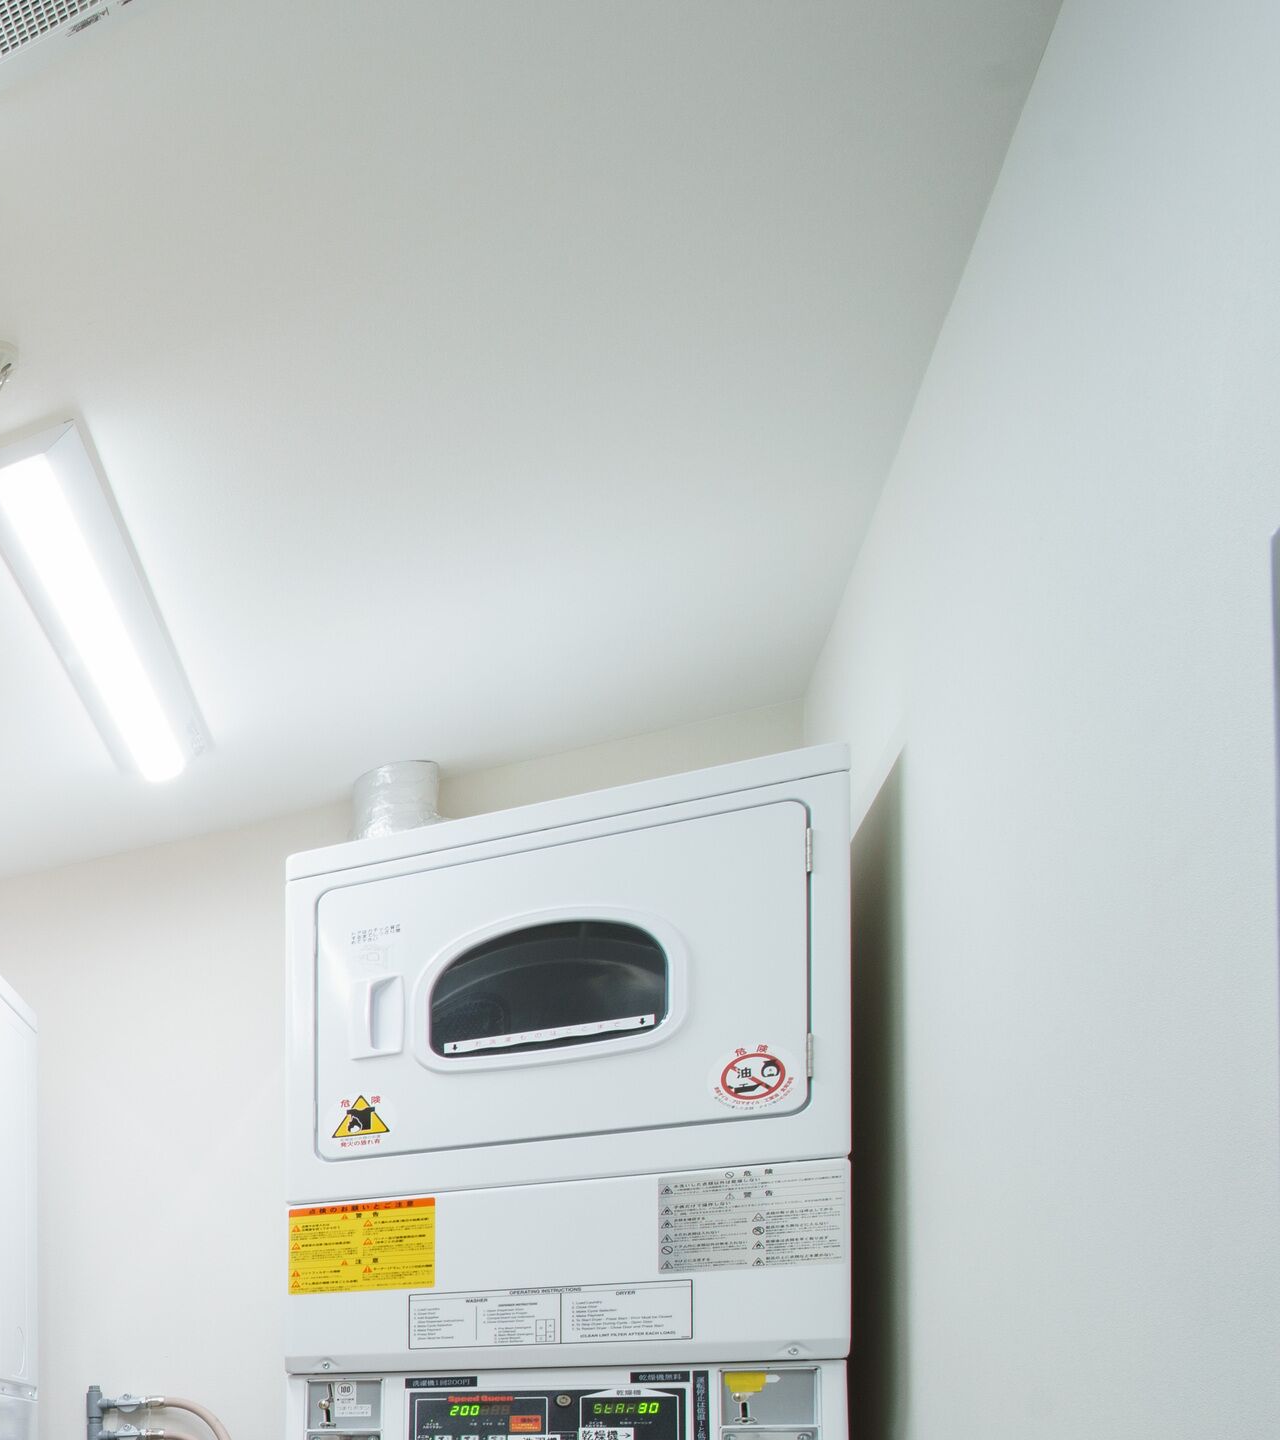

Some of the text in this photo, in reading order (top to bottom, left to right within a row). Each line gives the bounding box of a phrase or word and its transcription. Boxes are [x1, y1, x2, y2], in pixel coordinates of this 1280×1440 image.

[735, 1044, 768, 1056] 危険
[737, 1067, 752, 1078] 油
[308, 1200, 415, 1215] 点検のお願いとご注意
[541, 1287, 582, 1295] INSTRUCTIONS
[340, 1386, 351, 1394] 100
[447, 1395, 480, 1403] Speed
[449, 1405, 481, 1417] 200
[581, 1429, 619, 1440] 乾燥機
